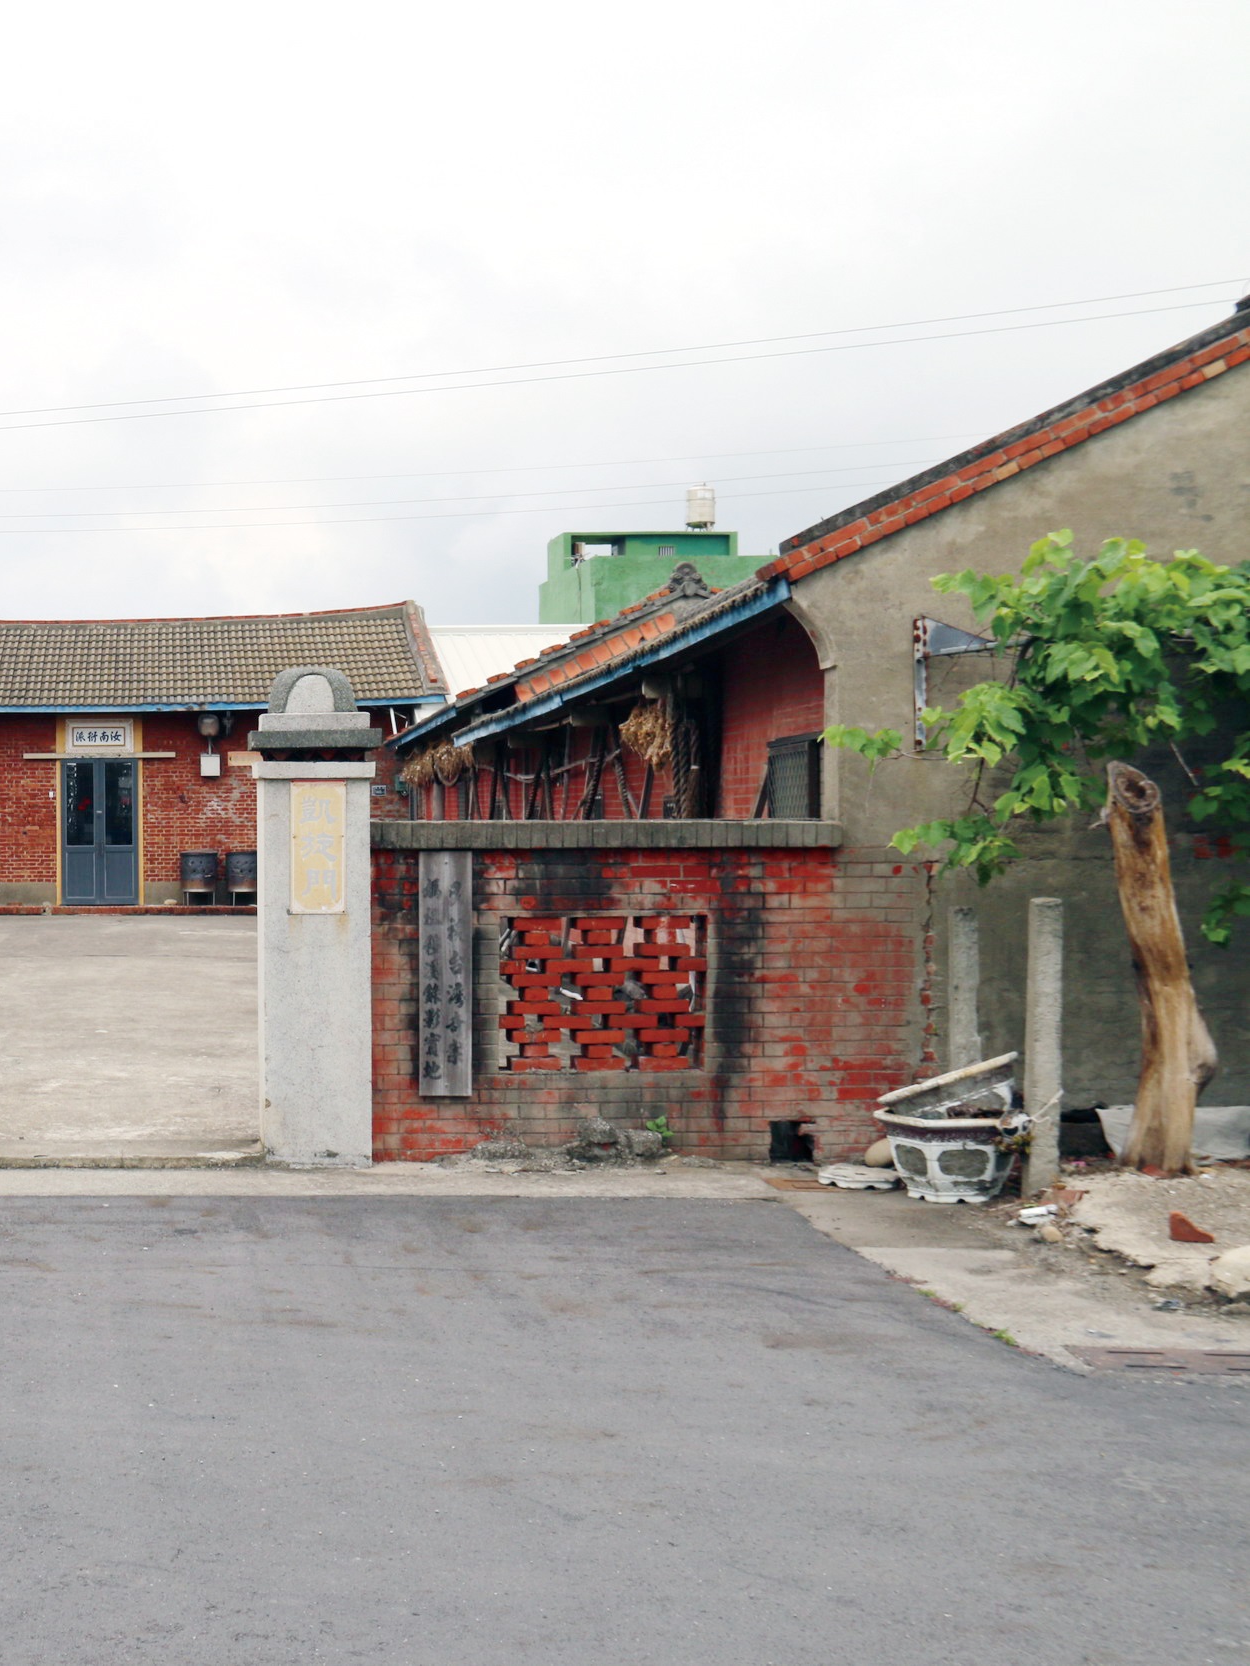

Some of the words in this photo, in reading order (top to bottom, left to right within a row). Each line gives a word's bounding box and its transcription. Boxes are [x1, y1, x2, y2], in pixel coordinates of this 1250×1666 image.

[75, 730, 122, 743] 汝南衍派
[299, 795, 340, 903] 凱旋門
